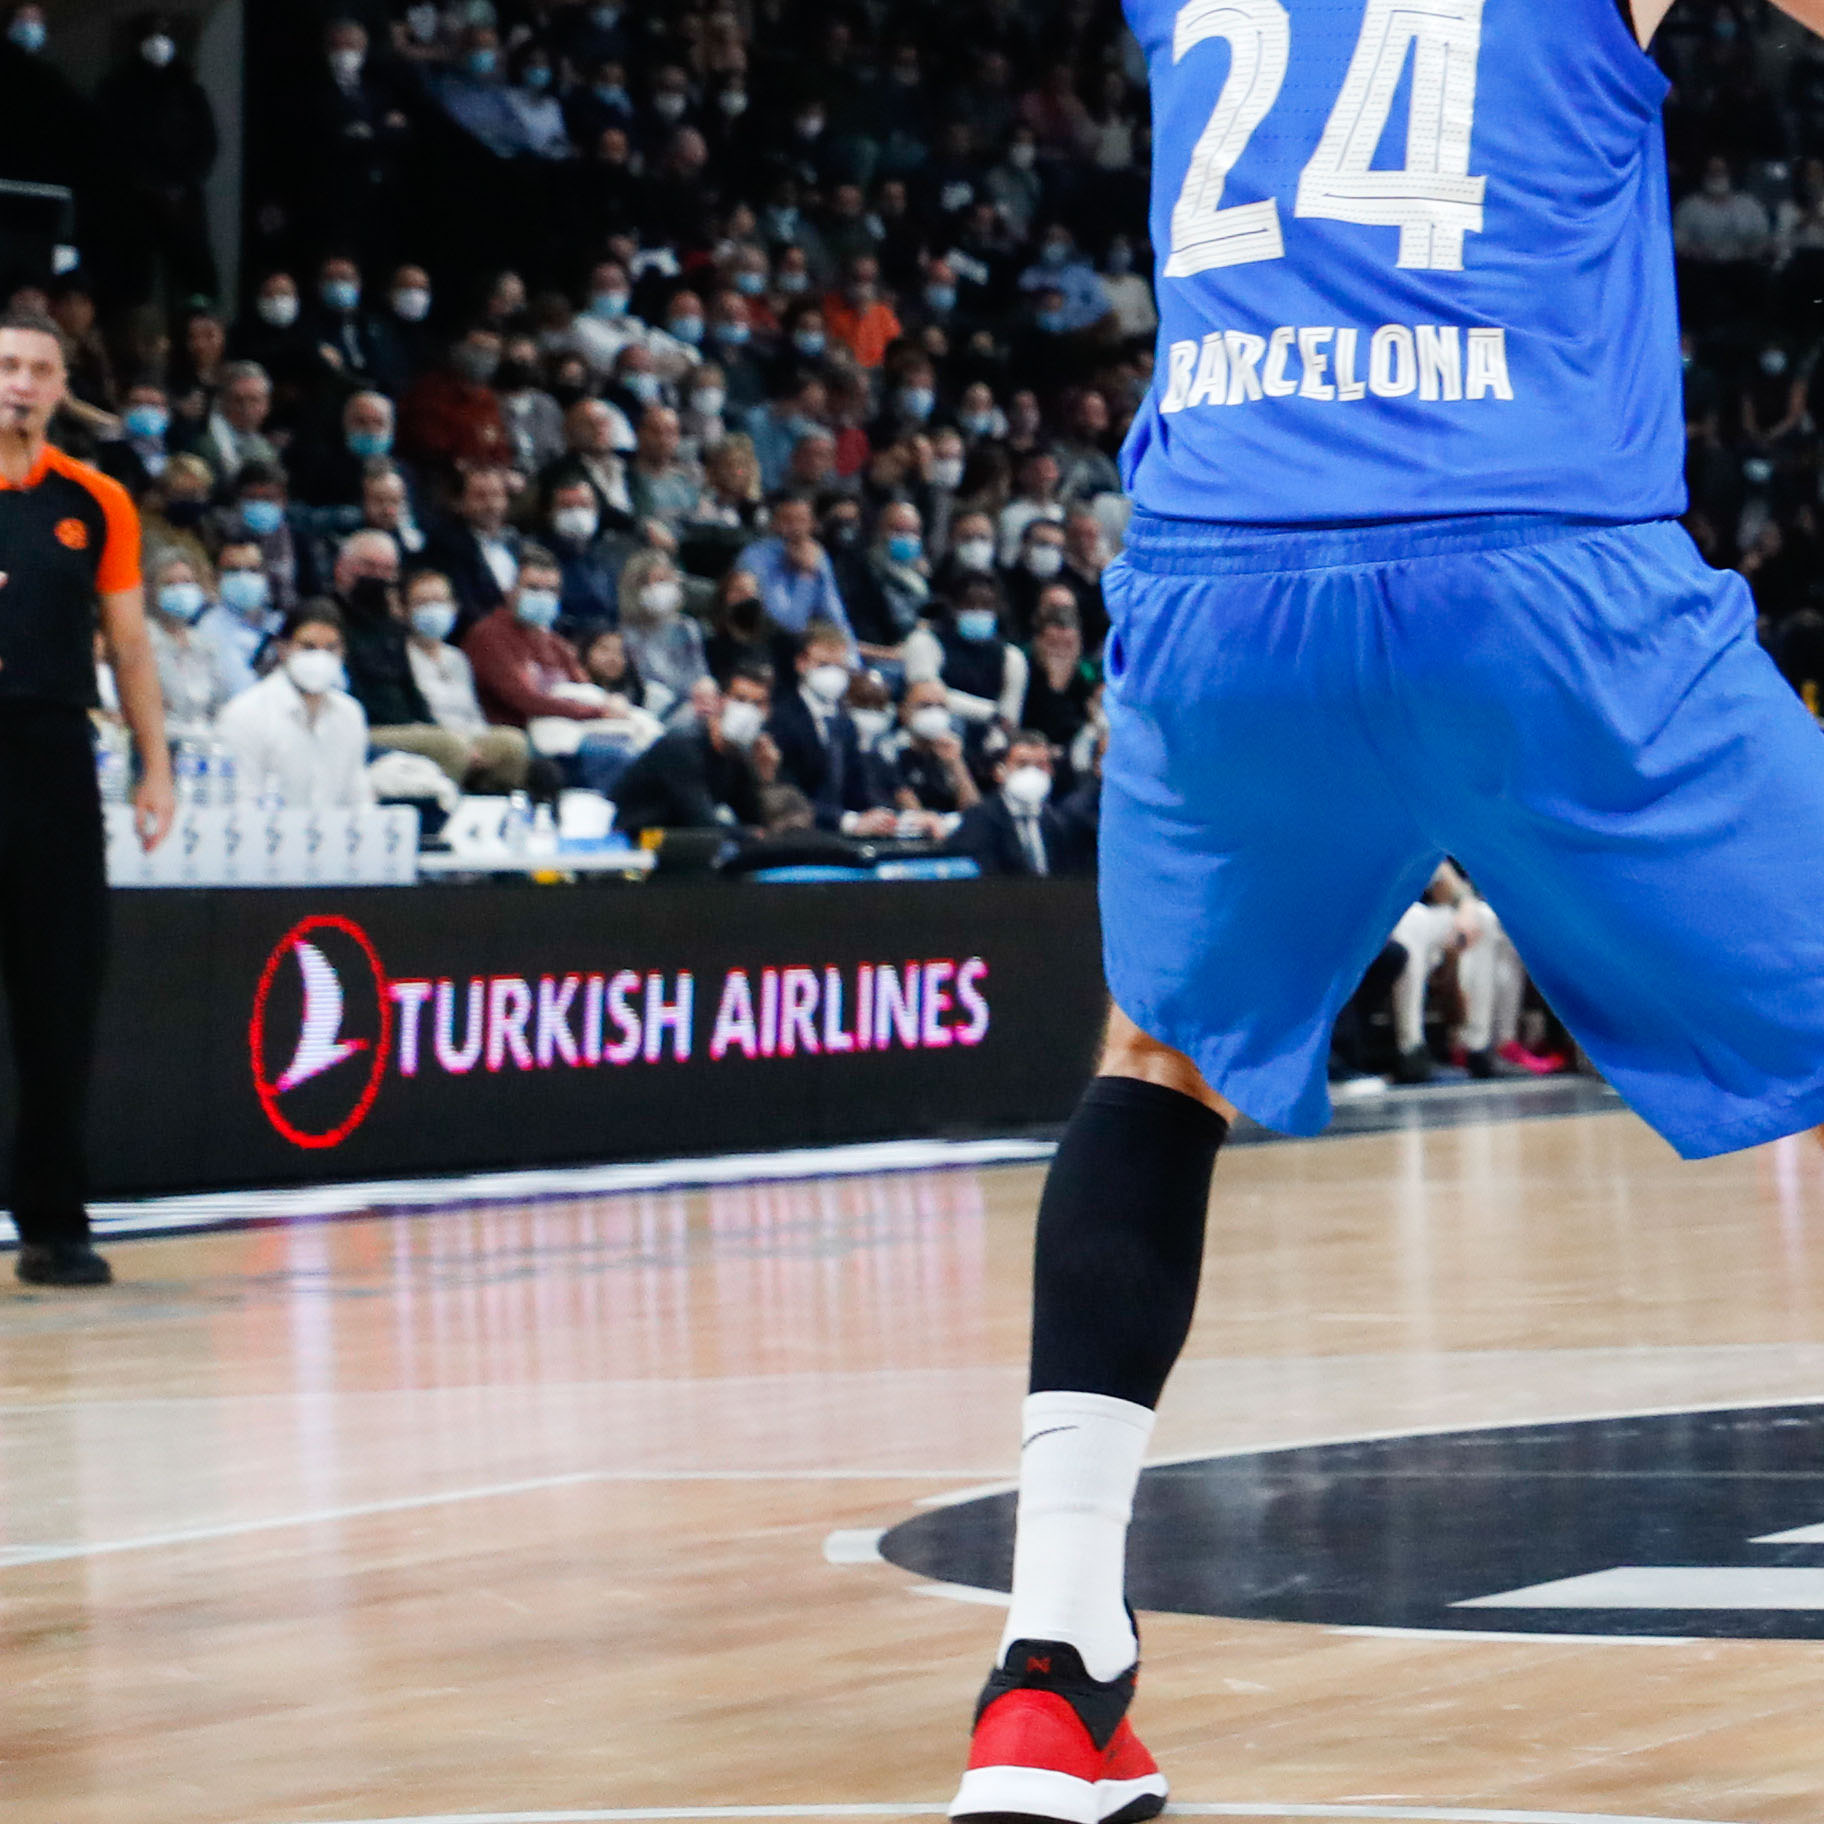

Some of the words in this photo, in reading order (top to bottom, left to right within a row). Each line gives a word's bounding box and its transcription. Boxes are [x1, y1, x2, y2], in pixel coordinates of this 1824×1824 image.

[1160, 324, 1514, 414] BARCELONA
[390, 969, 696, 1078] TURKISH
[709, 956, 990, 1061] AIRLINES
